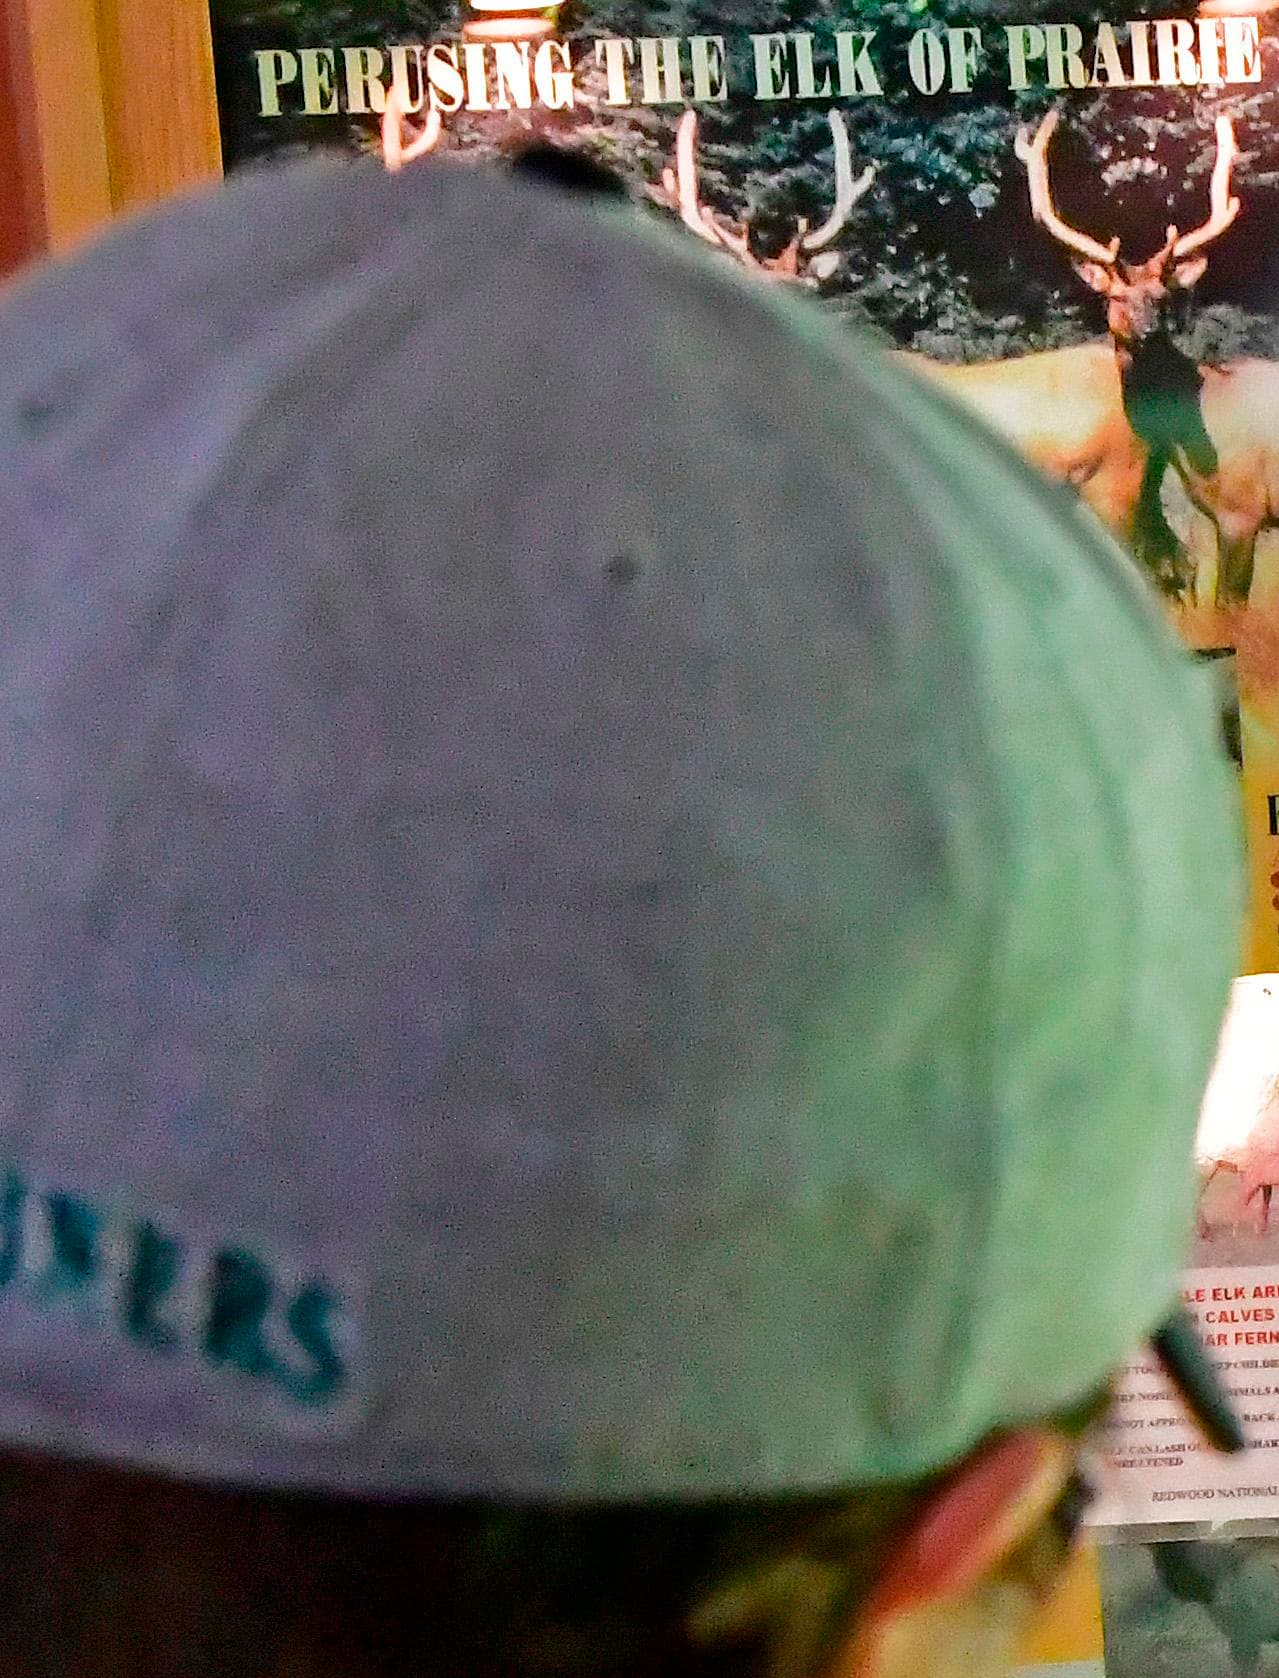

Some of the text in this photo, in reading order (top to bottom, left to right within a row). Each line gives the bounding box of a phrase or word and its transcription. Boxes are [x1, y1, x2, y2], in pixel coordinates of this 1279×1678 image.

[256, 39, 576, 118] PERUSING
[595, 34, 729, 107] THE
[749, 31, 885, 101] ELK
[907, 27, 984, 96] OF
[1004, 15, 1263, 92] PRAIRIE
[1211, 1286, 1246, 1302] ELK
[1205, 1308, 1275, 1324] CALVES
[1234, 1330, 1279, 1346] FERN
[1151, 1489, 1215, 1502] REDWOOD
